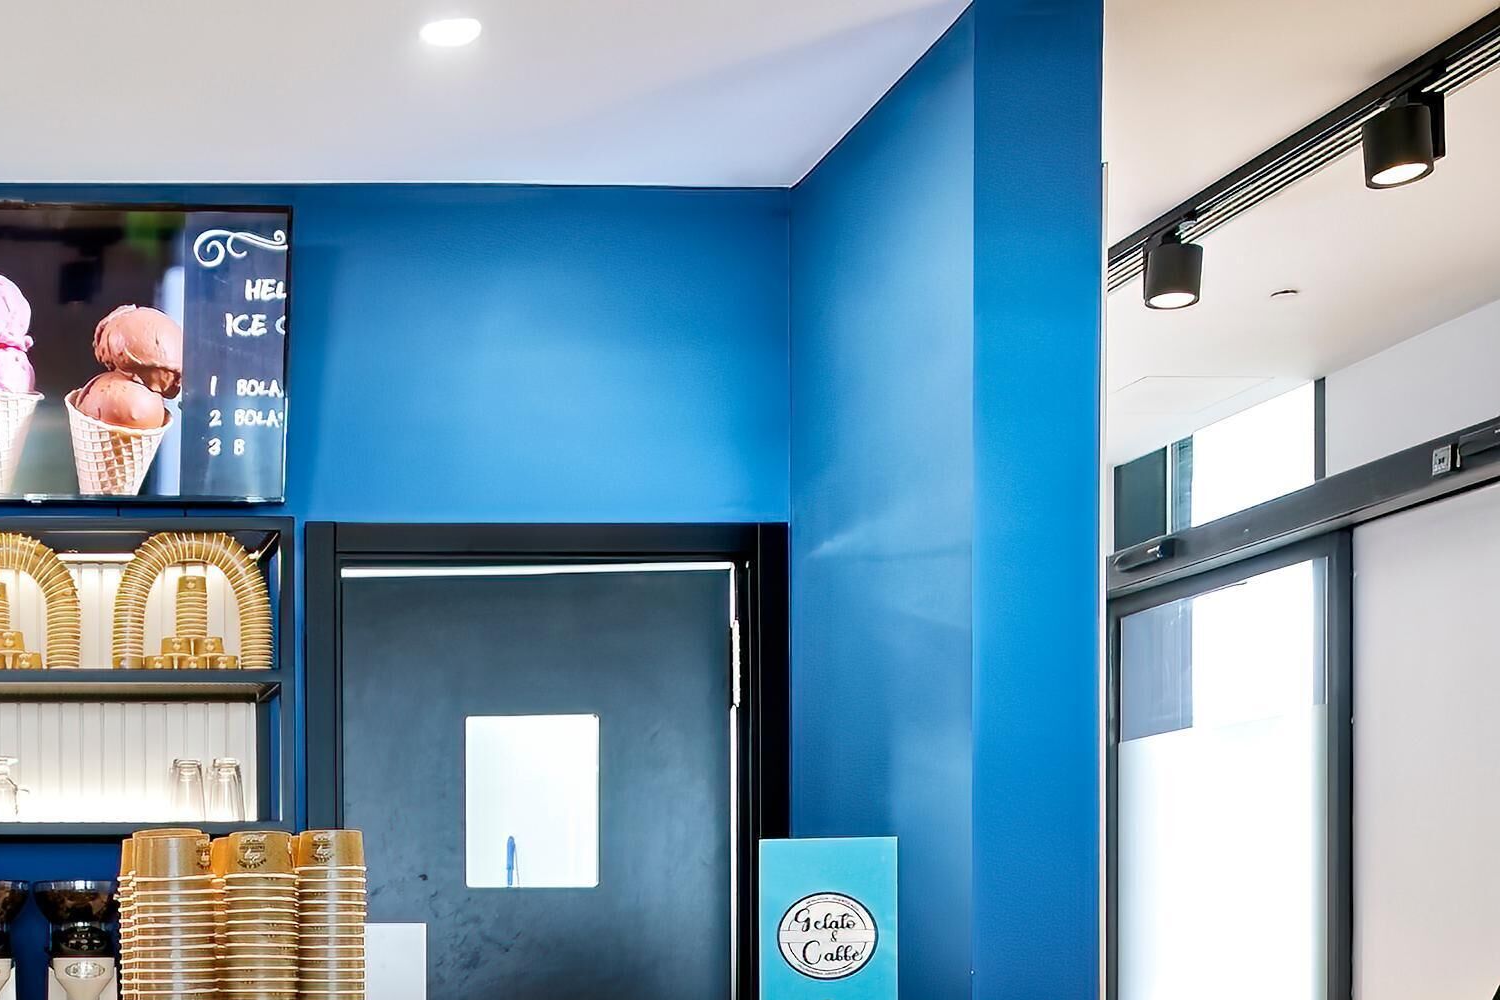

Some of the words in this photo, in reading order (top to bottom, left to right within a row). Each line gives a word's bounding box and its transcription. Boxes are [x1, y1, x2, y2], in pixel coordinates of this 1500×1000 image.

[225, 313, 267, 337] ICE
[210, 375, 218, 397] 1
[209, 409, 222, 427] 2
[208, 438, 221, 456] 3
[794, 907, 856, 932] Gelato
